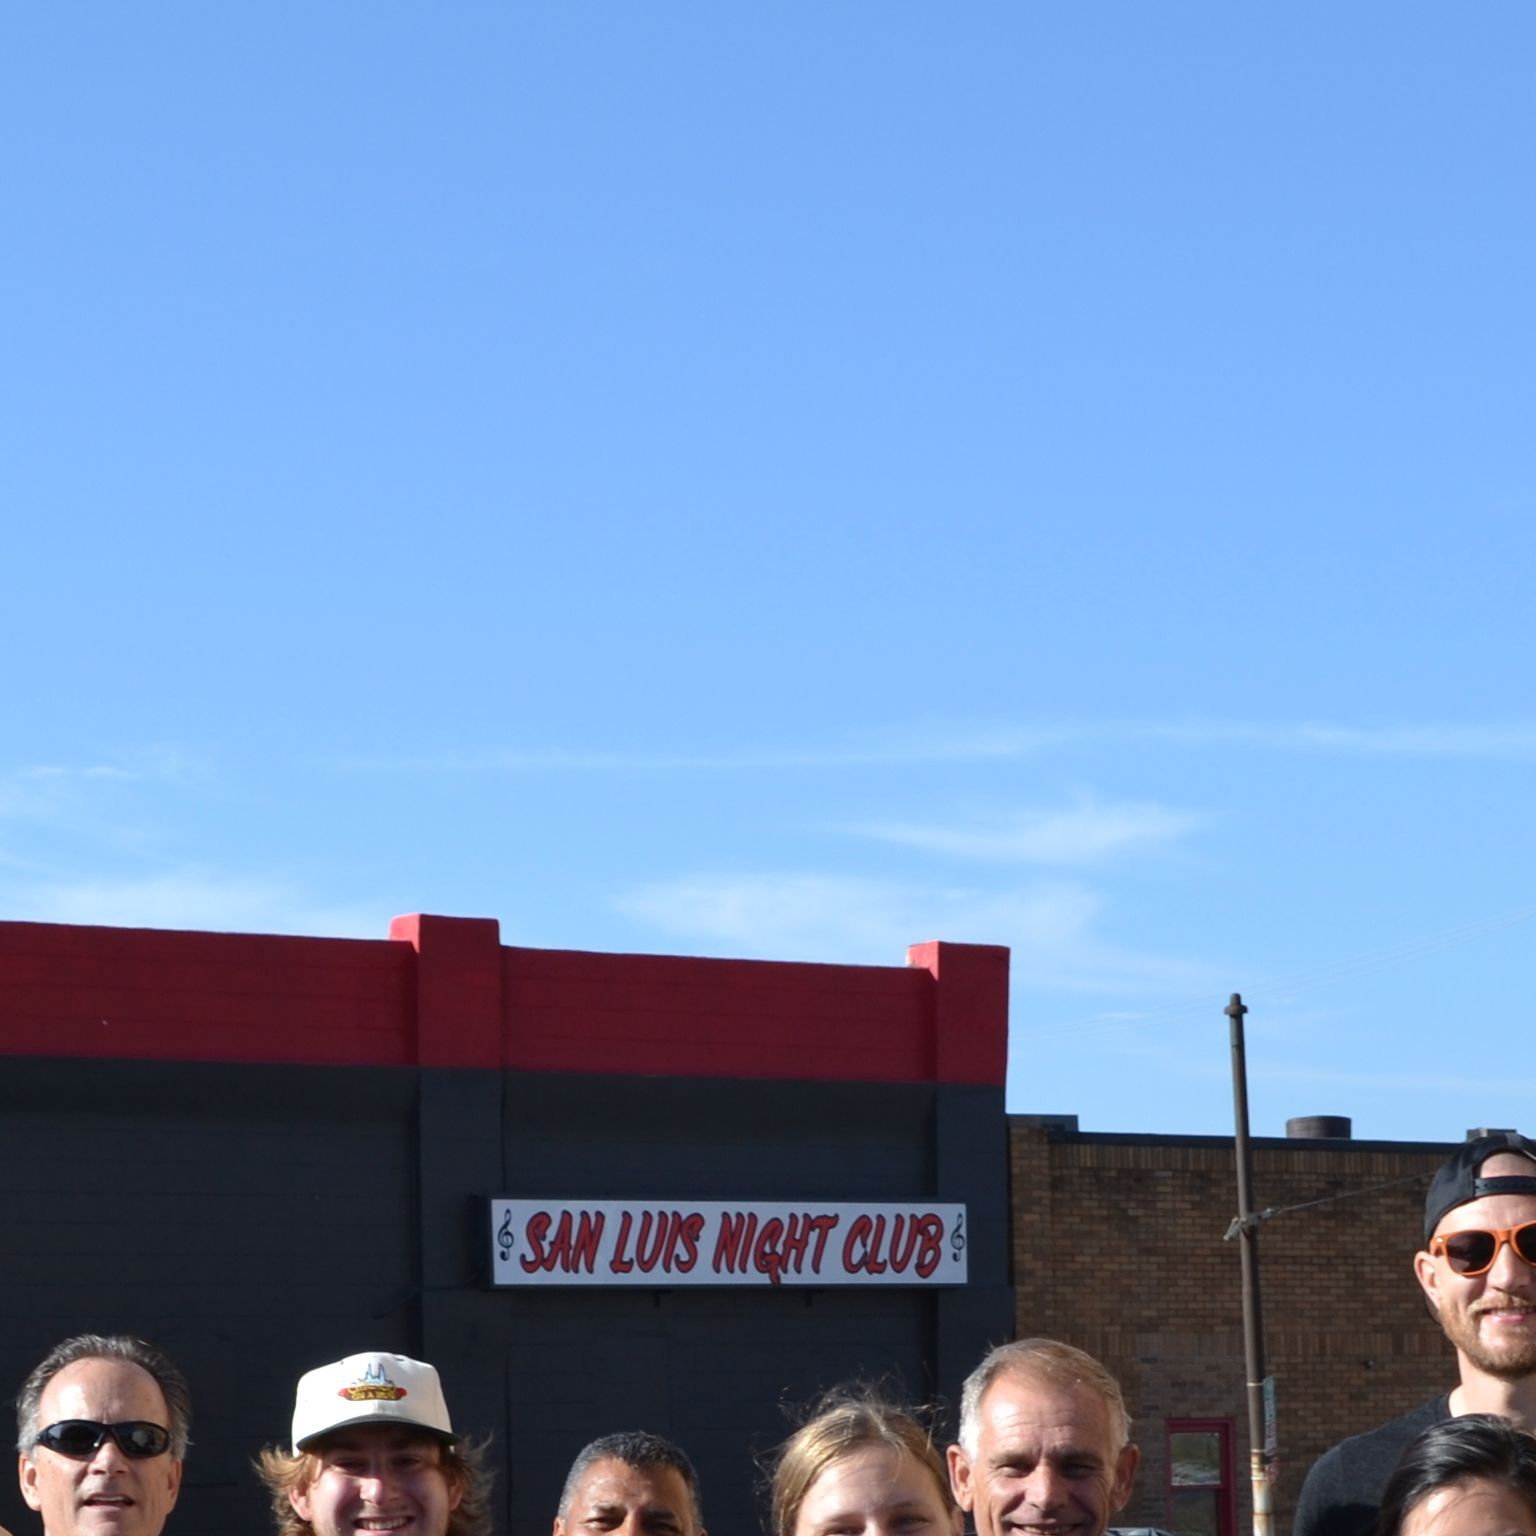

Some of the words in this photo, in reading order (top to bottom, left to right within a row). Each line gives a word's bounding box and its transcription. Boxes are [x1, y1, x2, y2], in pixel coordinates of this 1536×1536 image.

[520, 1210, 604, 1274] SAN
[609, 1210, 704, 1275] LUIS
[712, 1211, 839, 1285] NIGHT
[842, 1213, 945, 1278] CLUB
